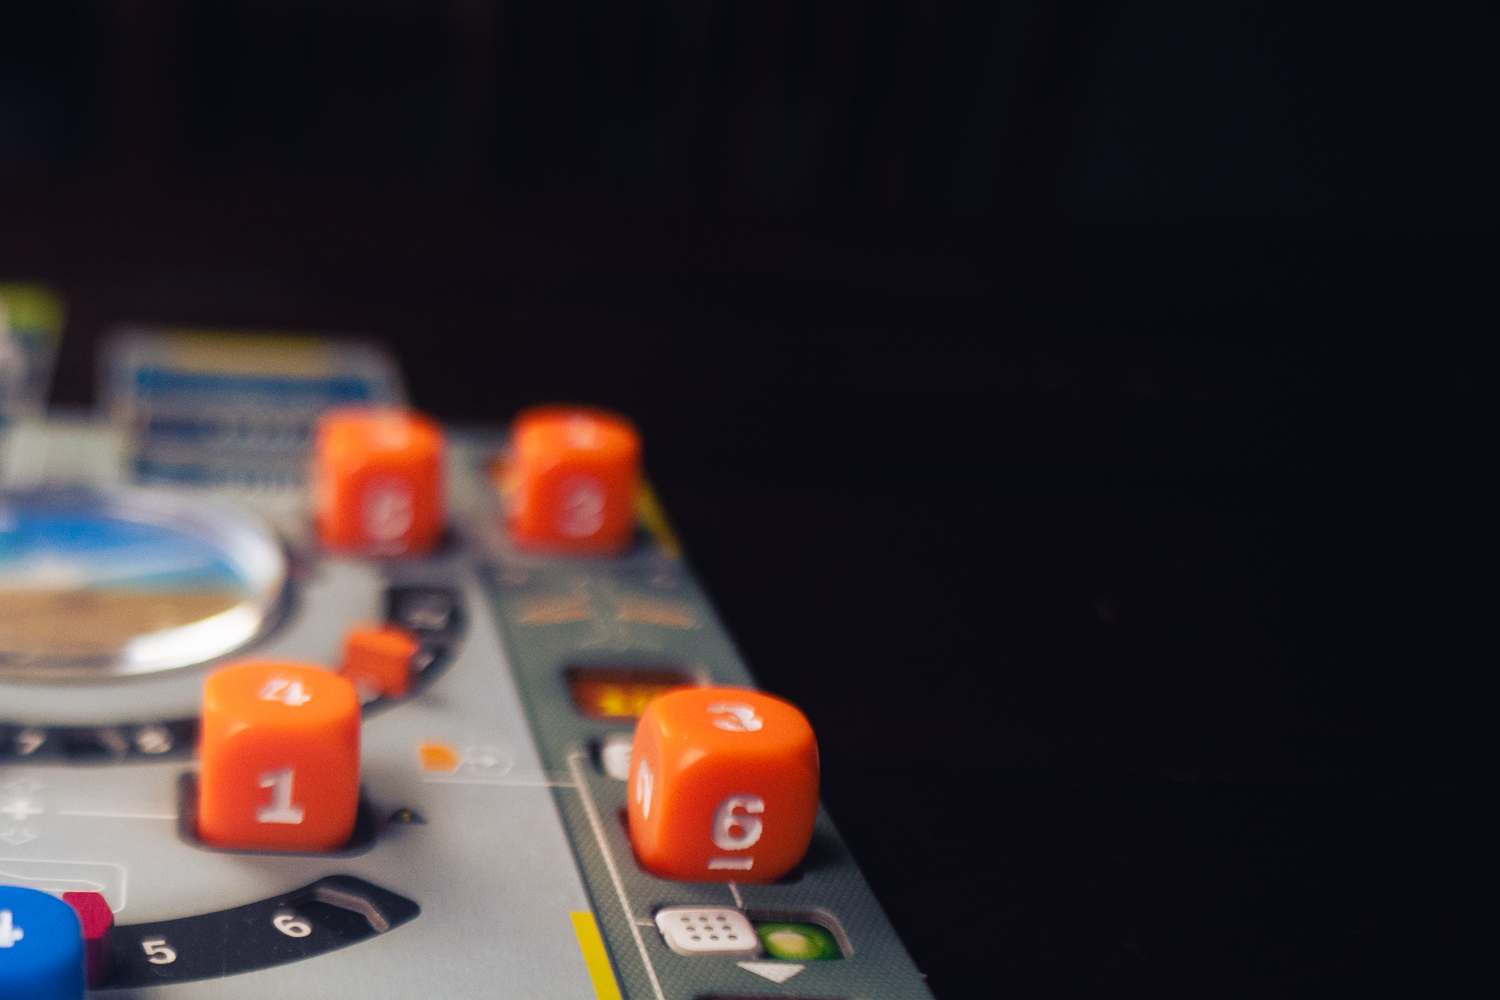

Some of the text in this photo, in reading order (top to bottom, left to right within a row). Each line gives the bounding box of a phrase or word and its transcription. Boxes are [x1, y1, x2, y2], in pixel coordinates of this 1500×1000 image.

[259, 679, 312, 706] 4
[255, 769, 304, 825] 1
[710, 795, 765, 851] 6
[141, 939, 177, 965] 5
[273, 915, 312, 938] 6
